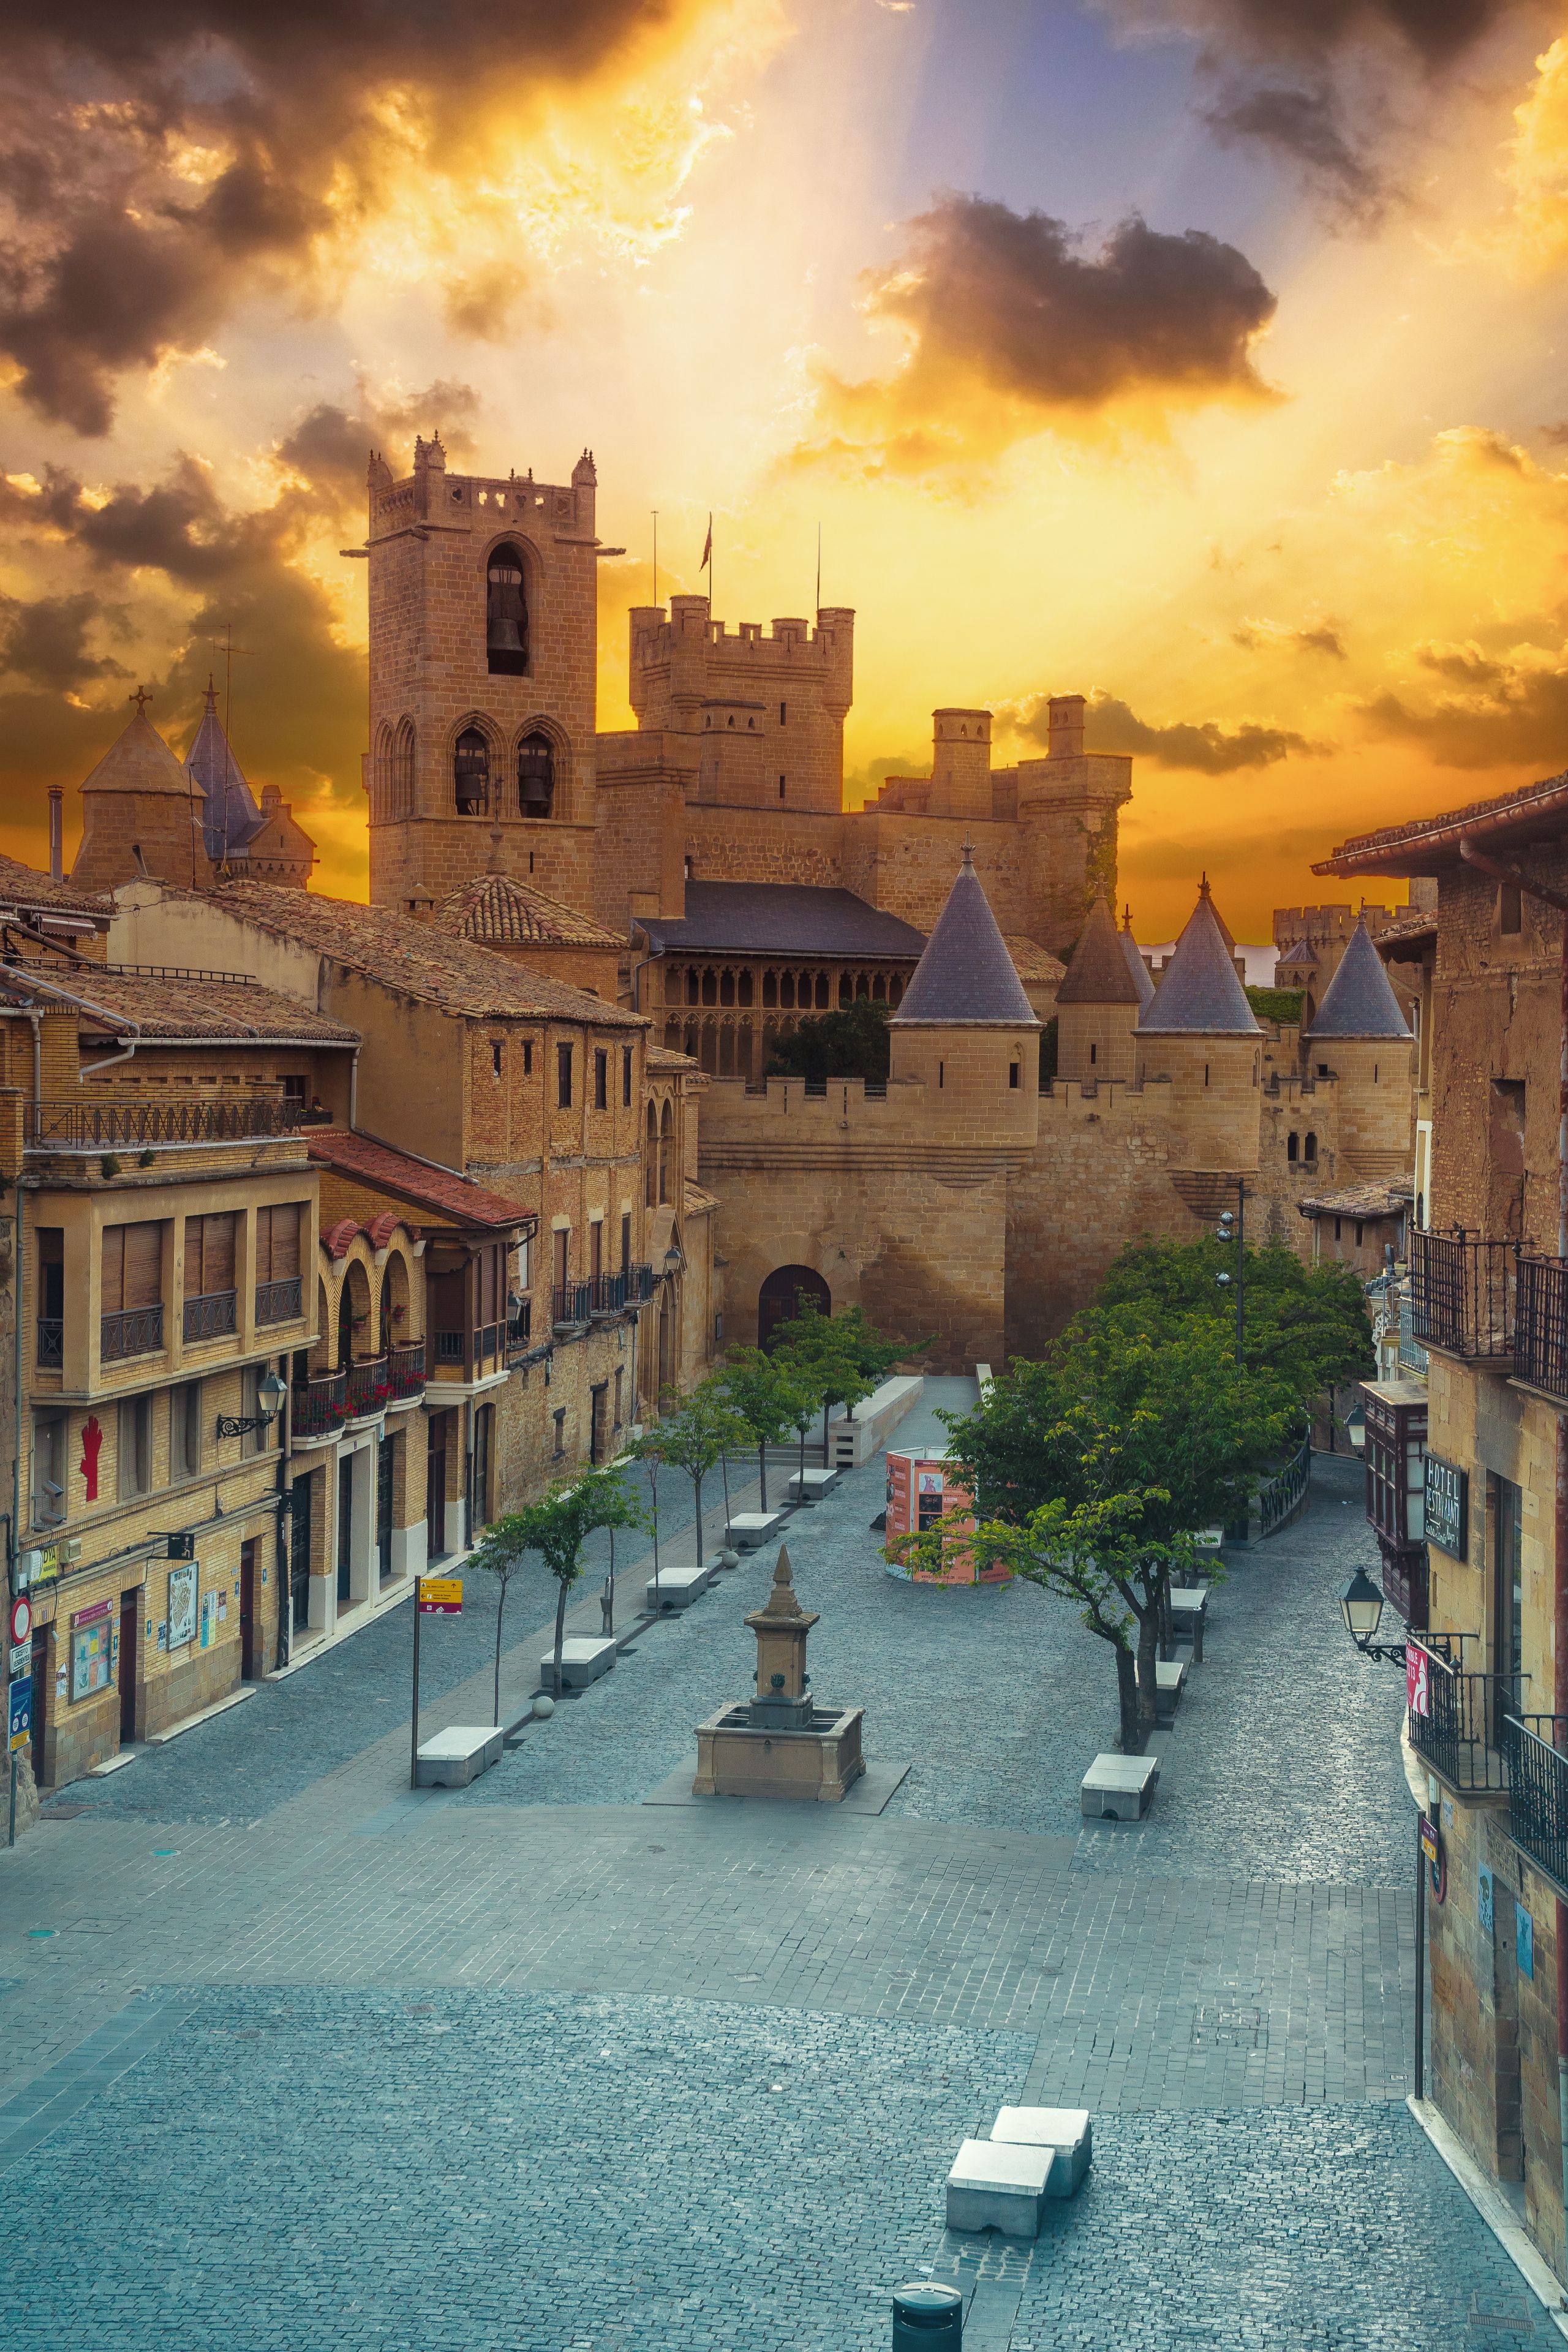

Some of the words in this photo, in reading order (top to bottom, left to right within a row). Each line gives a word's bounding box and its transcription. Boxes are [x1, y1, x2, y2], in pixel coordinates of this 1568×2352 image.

[1428, 1458, 1458, 1501] HOTEL
[43, 1547, 56, 1564] DYA
[43, 1563, 56, 1572] NAVARRA
[96, 1608, 108, 1617] CULTURAL
[15, 1647, 28, 1658] EXCEPTO
[13, 1654, 29, 1667] RESIDENTES
